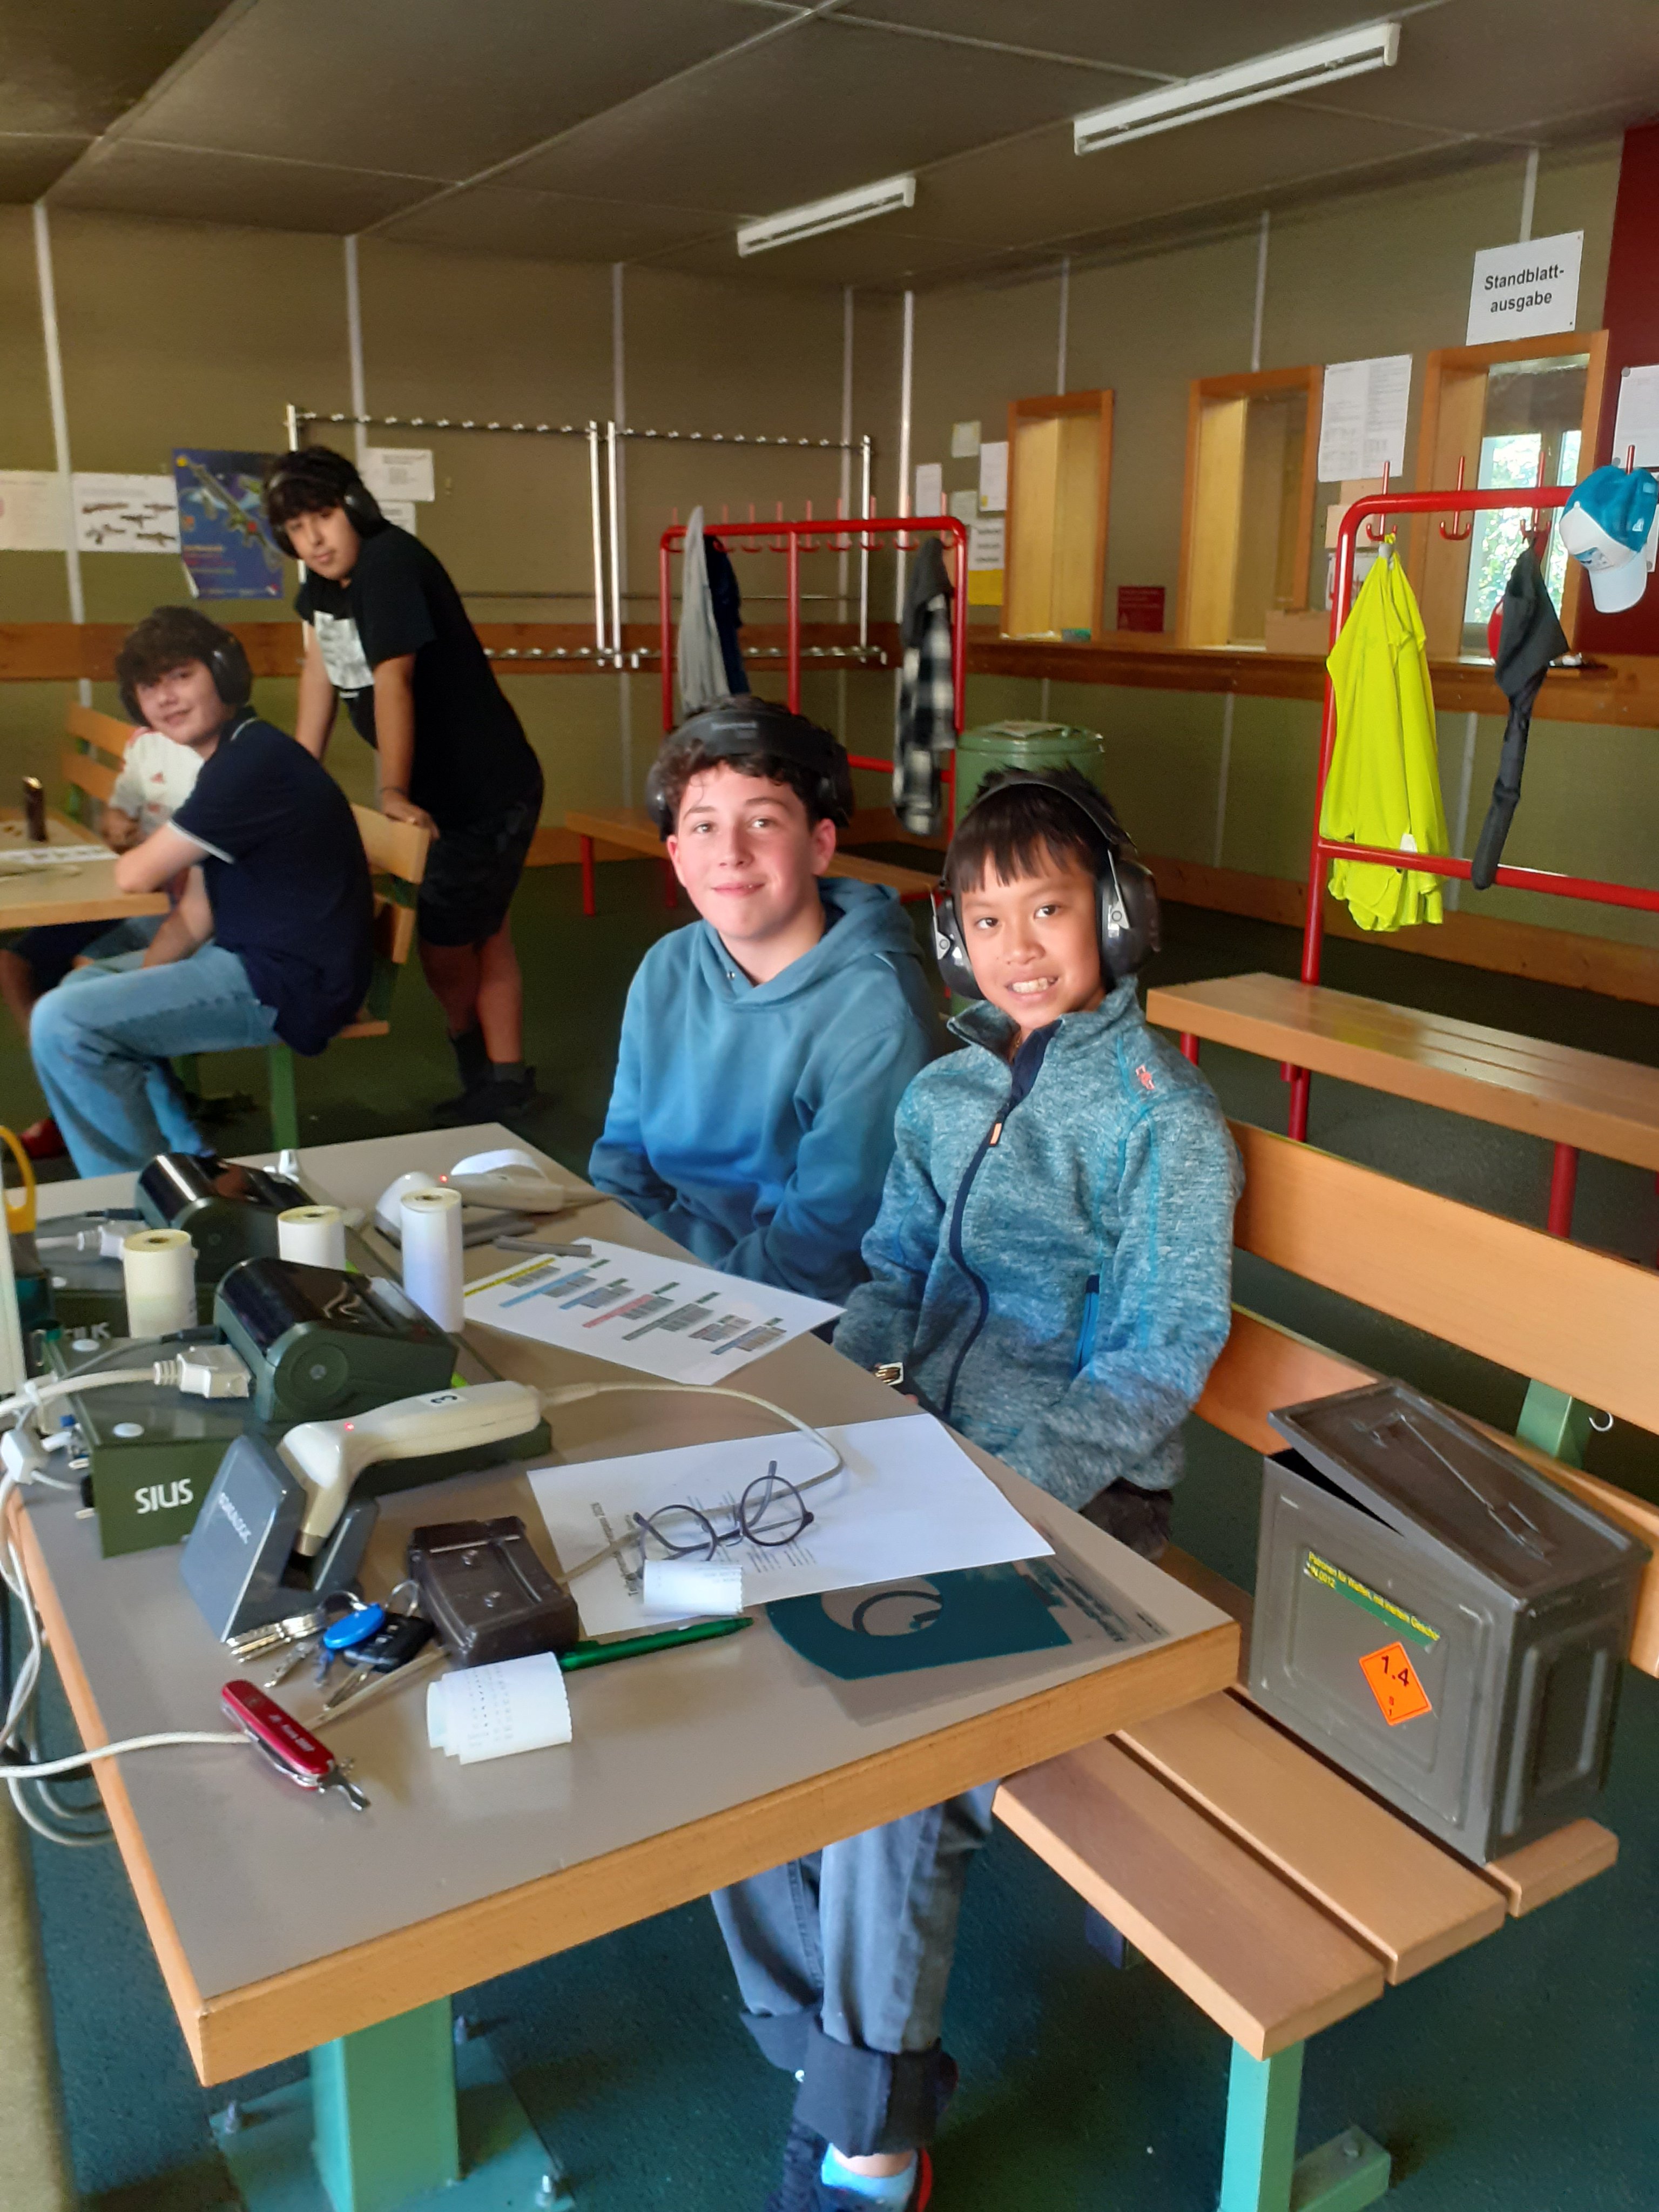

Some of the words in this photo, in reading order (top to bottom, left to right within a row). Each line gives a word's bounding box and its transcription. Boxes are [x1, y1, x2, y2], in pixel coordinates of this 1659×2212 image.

[1484, 264, 1564, 291] Standblatt-
[1491, 291, 1552, 313] ausgabe
[134, 1478, 194, 1514] SIUS
[1381, 1655, 1409, 1687] 1.4
